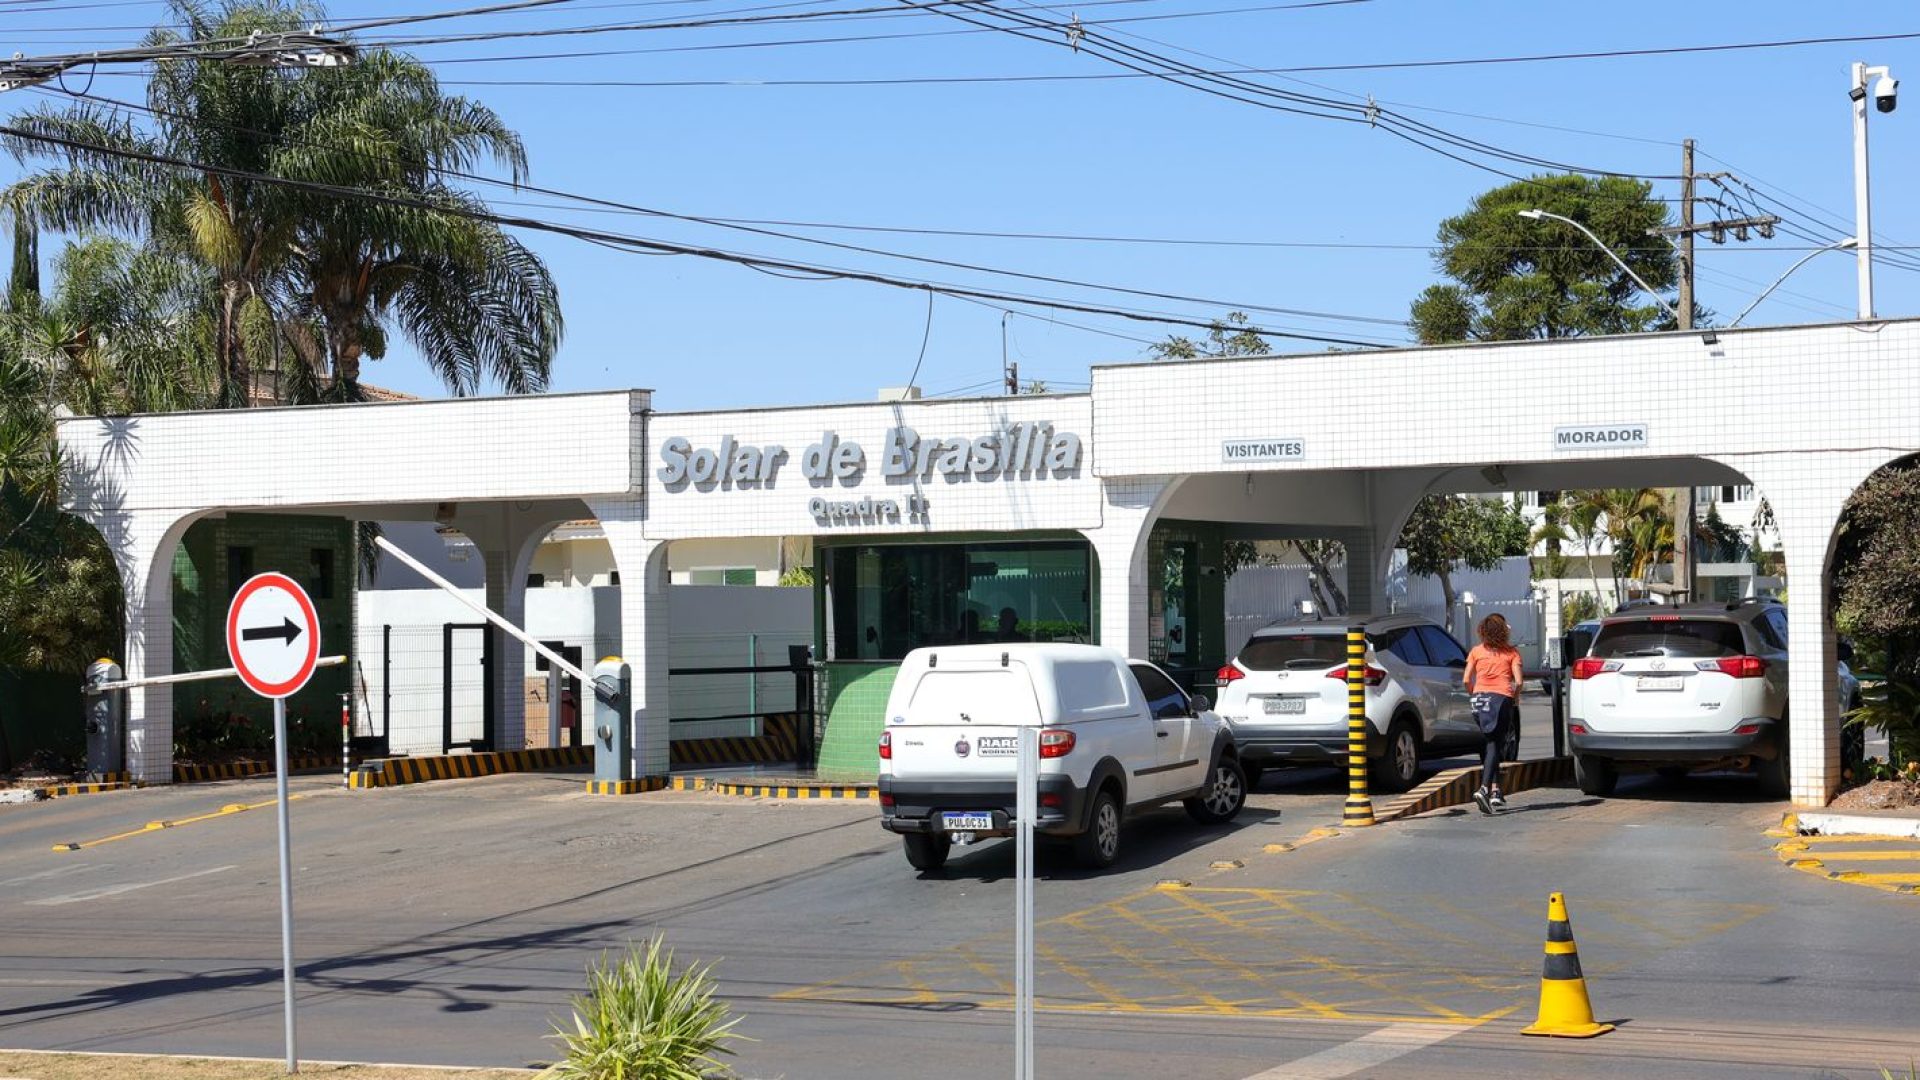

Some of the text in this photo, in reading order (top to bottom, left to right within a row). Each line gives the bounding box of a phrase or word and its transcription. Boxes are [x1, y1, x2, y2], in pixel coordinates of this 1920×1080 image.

[1558, 429, 1643, 444] MORADOR
[657, 434, 788, 491] Solar
[801, 429, 866, 487] de
[1226, 443, 1301, 457] VISITANTES
[809, 495, 900, 524] Quadra
